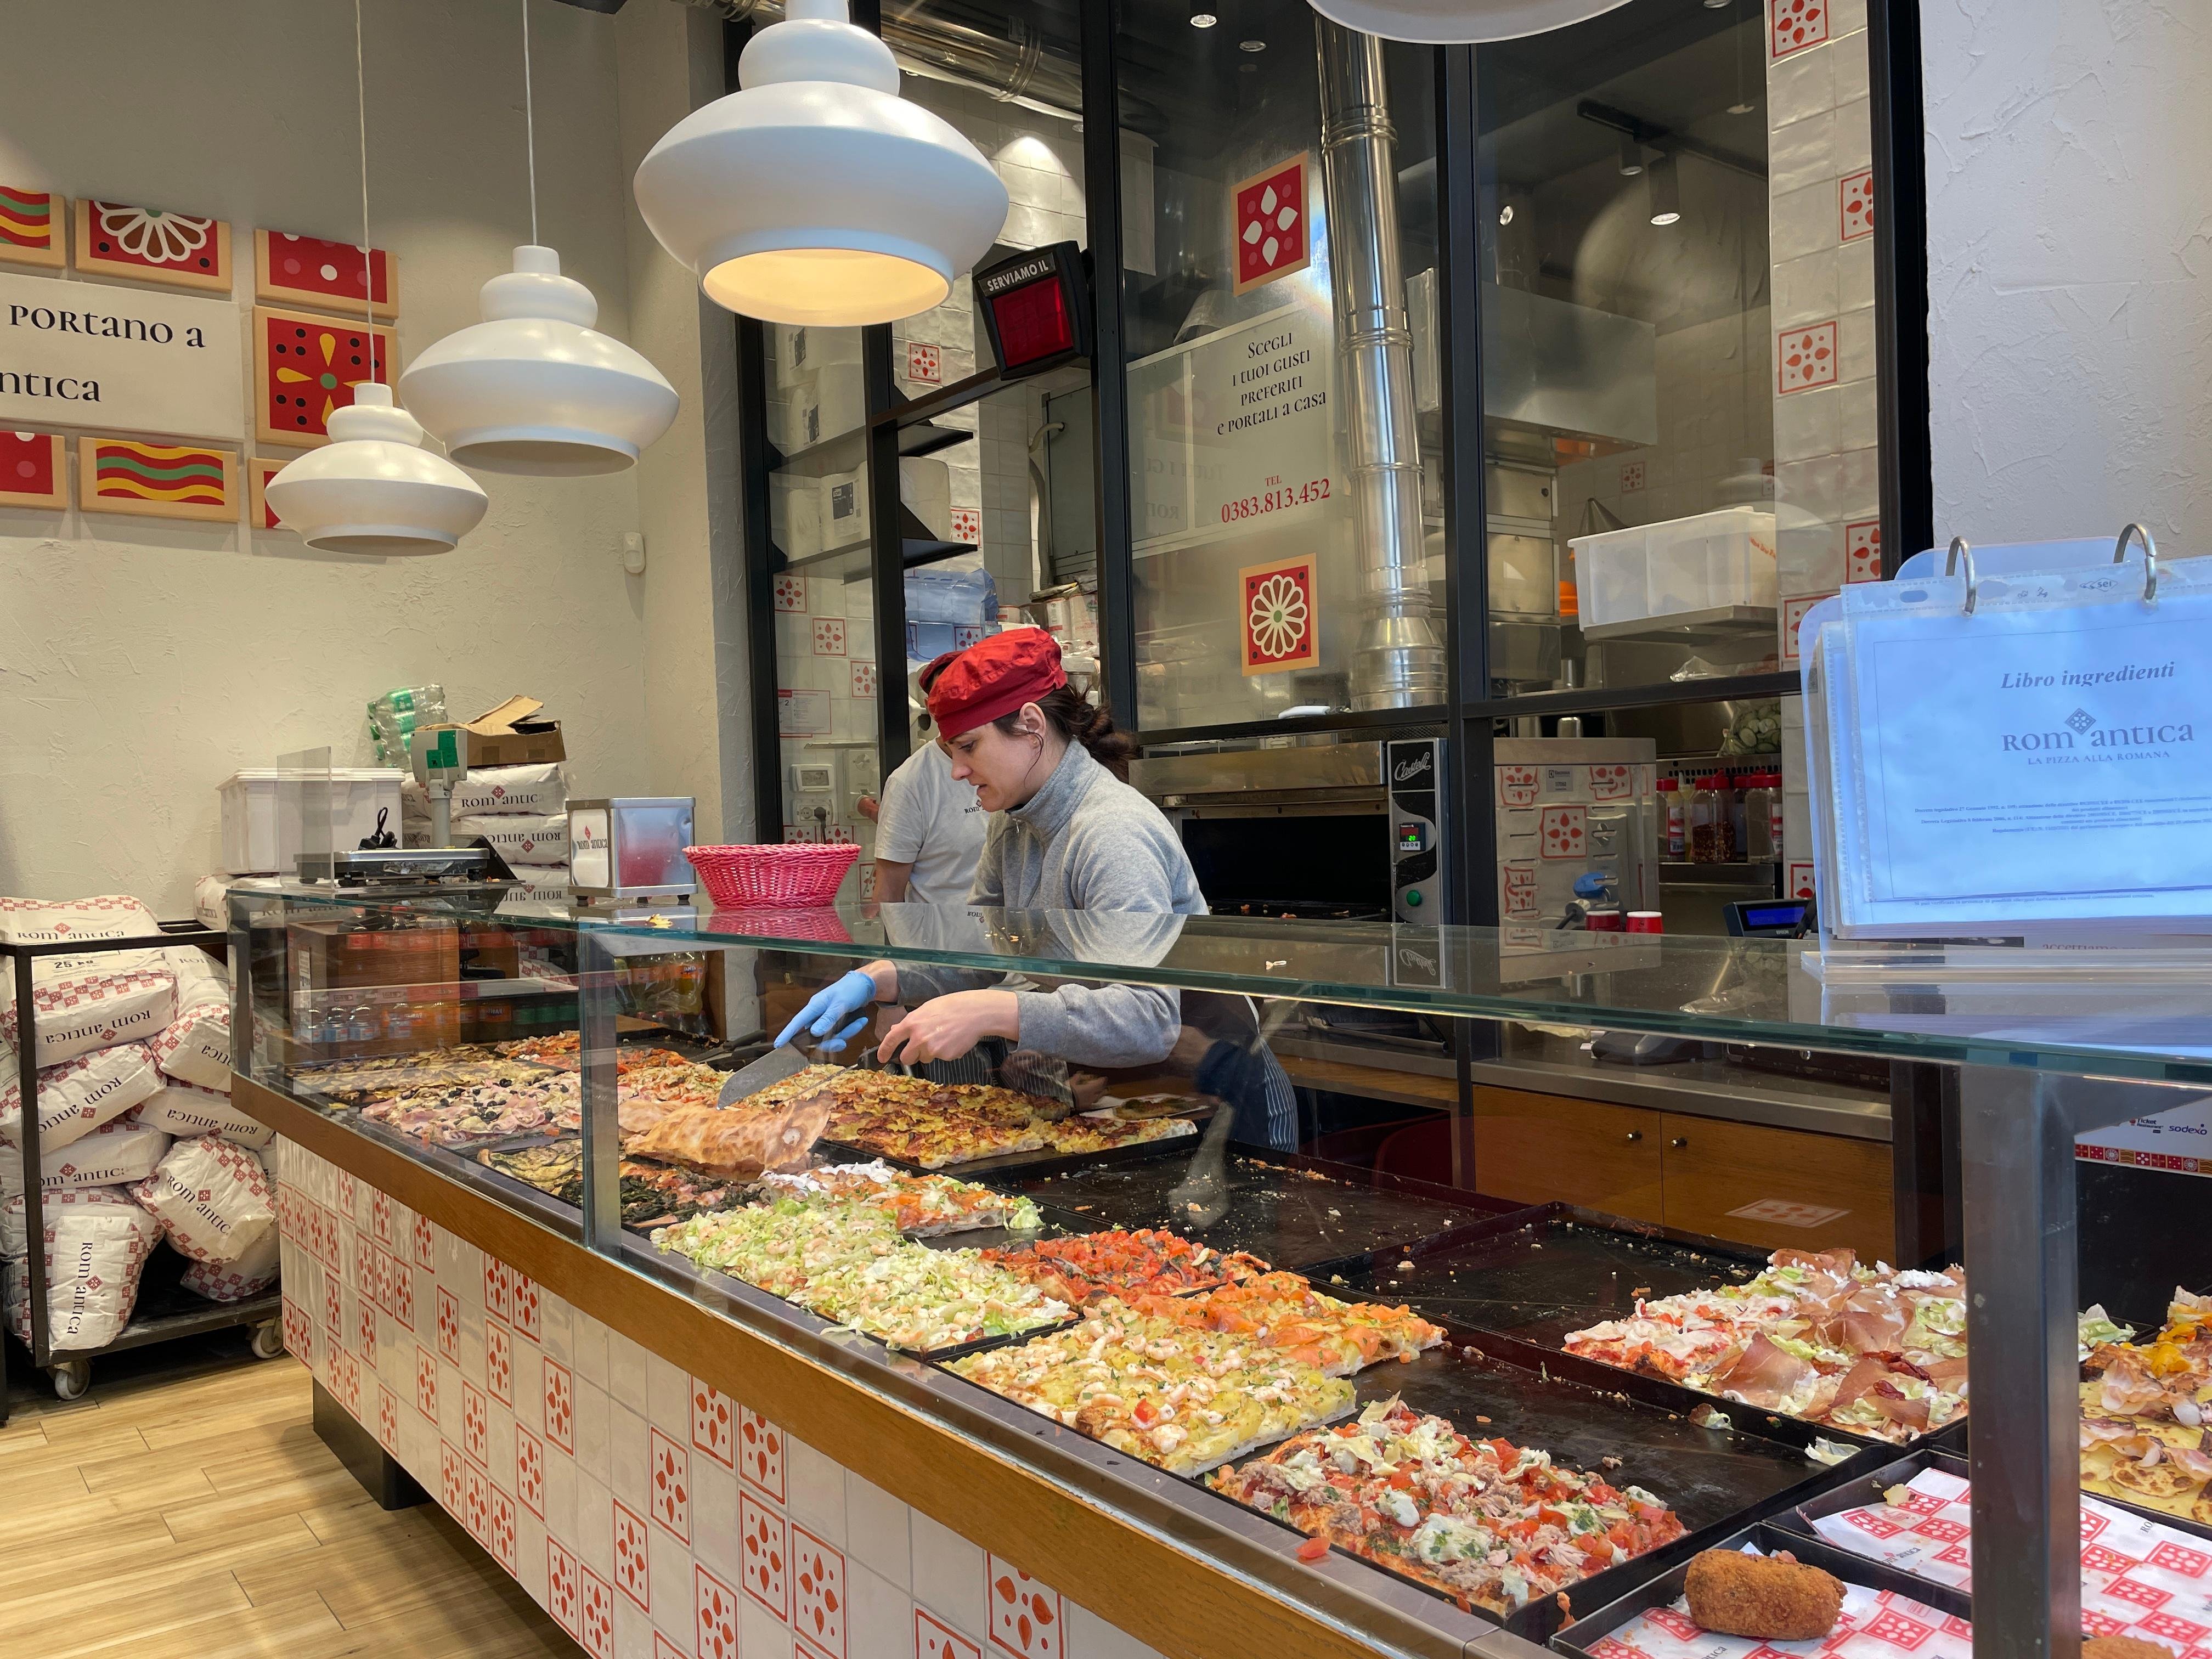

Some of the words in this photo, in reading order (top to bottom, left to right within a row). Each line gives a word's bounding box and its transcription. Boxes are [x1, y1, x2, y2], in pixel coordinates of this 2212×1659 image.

[987, 263, 1037, 292] SERVIAMO
[1038, 260, 1049, 274] IL
[186, 326, 206, 348] a
[1282, 403, 1290, 416] a
[1294, 392, 1327, 413] casa
[1265, 475, 1282, 487] TEL
[1221, 478, 1330, 523] 0383.813.452
[2001, 670, 2055, 690] Libro
[2062, 661, 2175, 687] ingredienti
[2028, 756, 2043, 765] LA
[2046, 755, 2080, 764] PIZZA
[2083, 753, 2113, 763] ALLA
[2116, 751, 2170, 761] ROMANA
[54, 960, 73, 969] 25
[2168, 1125, 2208, 1135] sodexo
